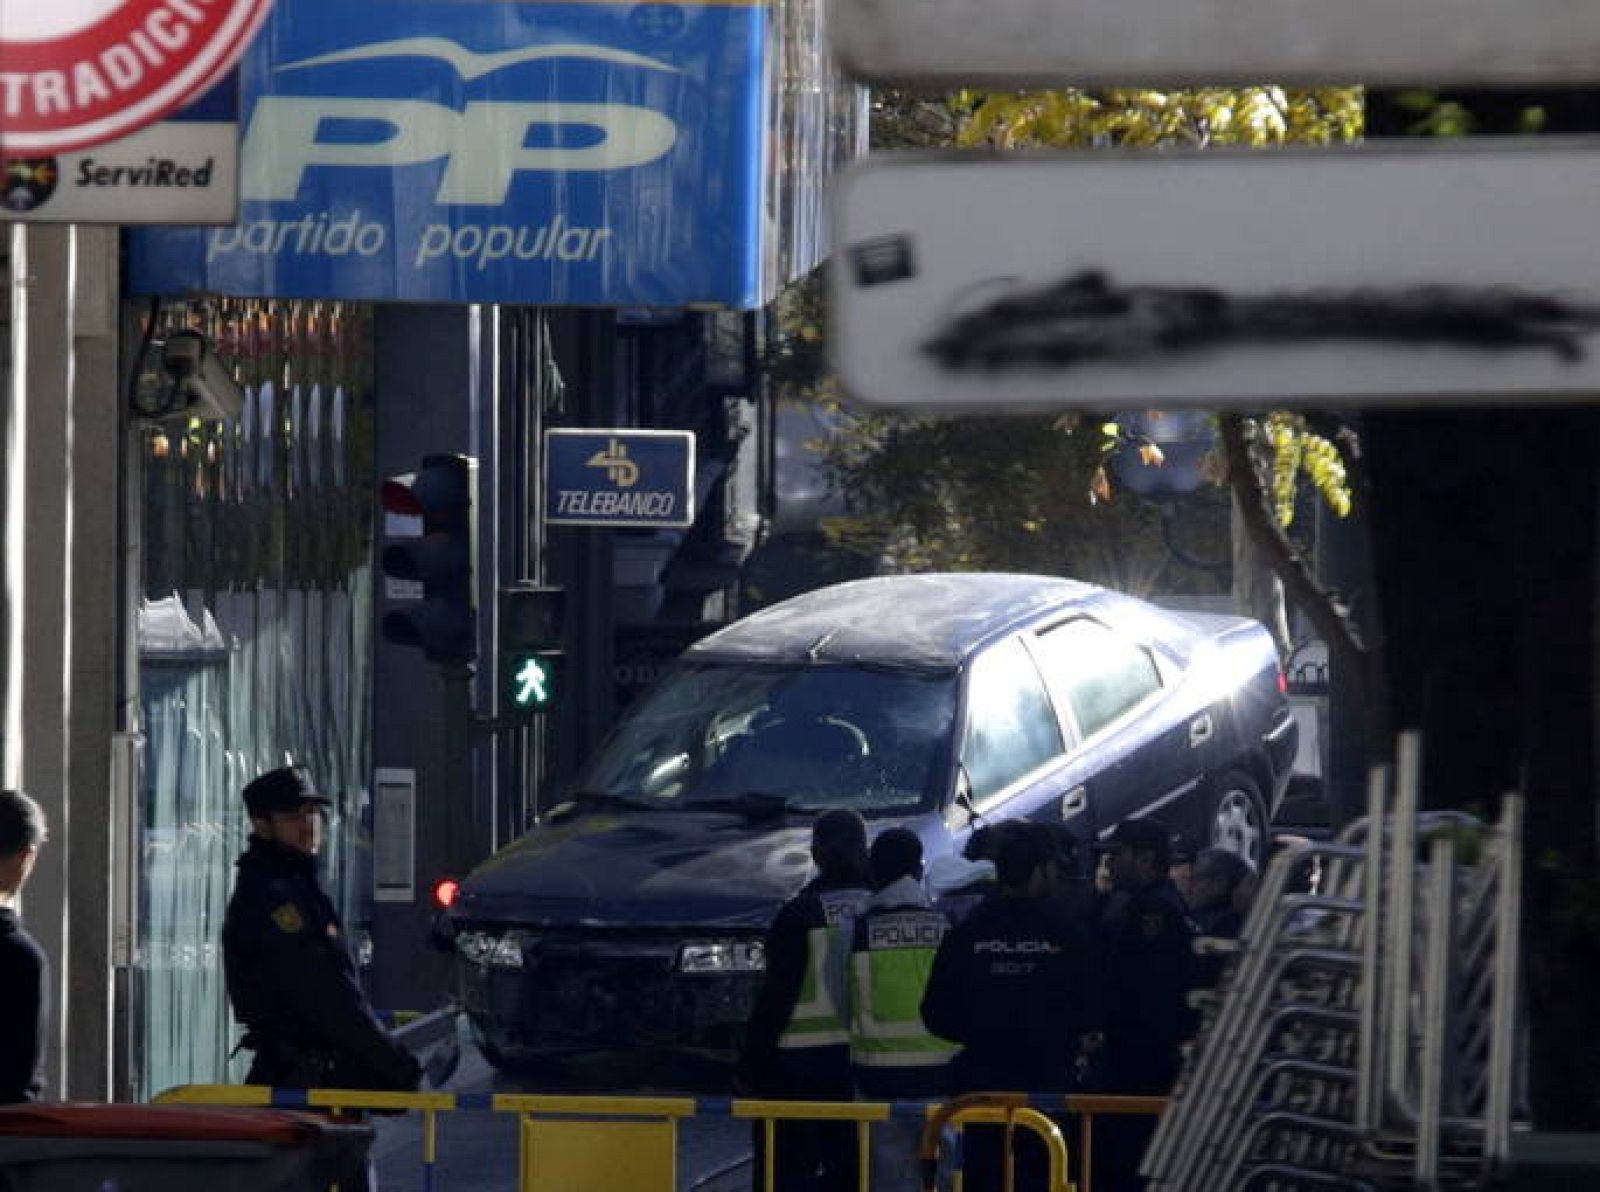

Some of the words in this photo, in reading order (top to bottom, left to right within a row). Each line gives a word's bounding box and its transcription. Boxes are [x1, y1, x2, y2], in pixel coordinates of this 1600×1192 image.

[0, 0, 206, 117] TRADICI
[75, 156, 214, 188] ServiRed
[242, 97, 676, 206] PP
[207, 209, 385, 263] partido
[415, 214, 611, 271] popular
[558, 490, 675, 515] TELEBANCO
